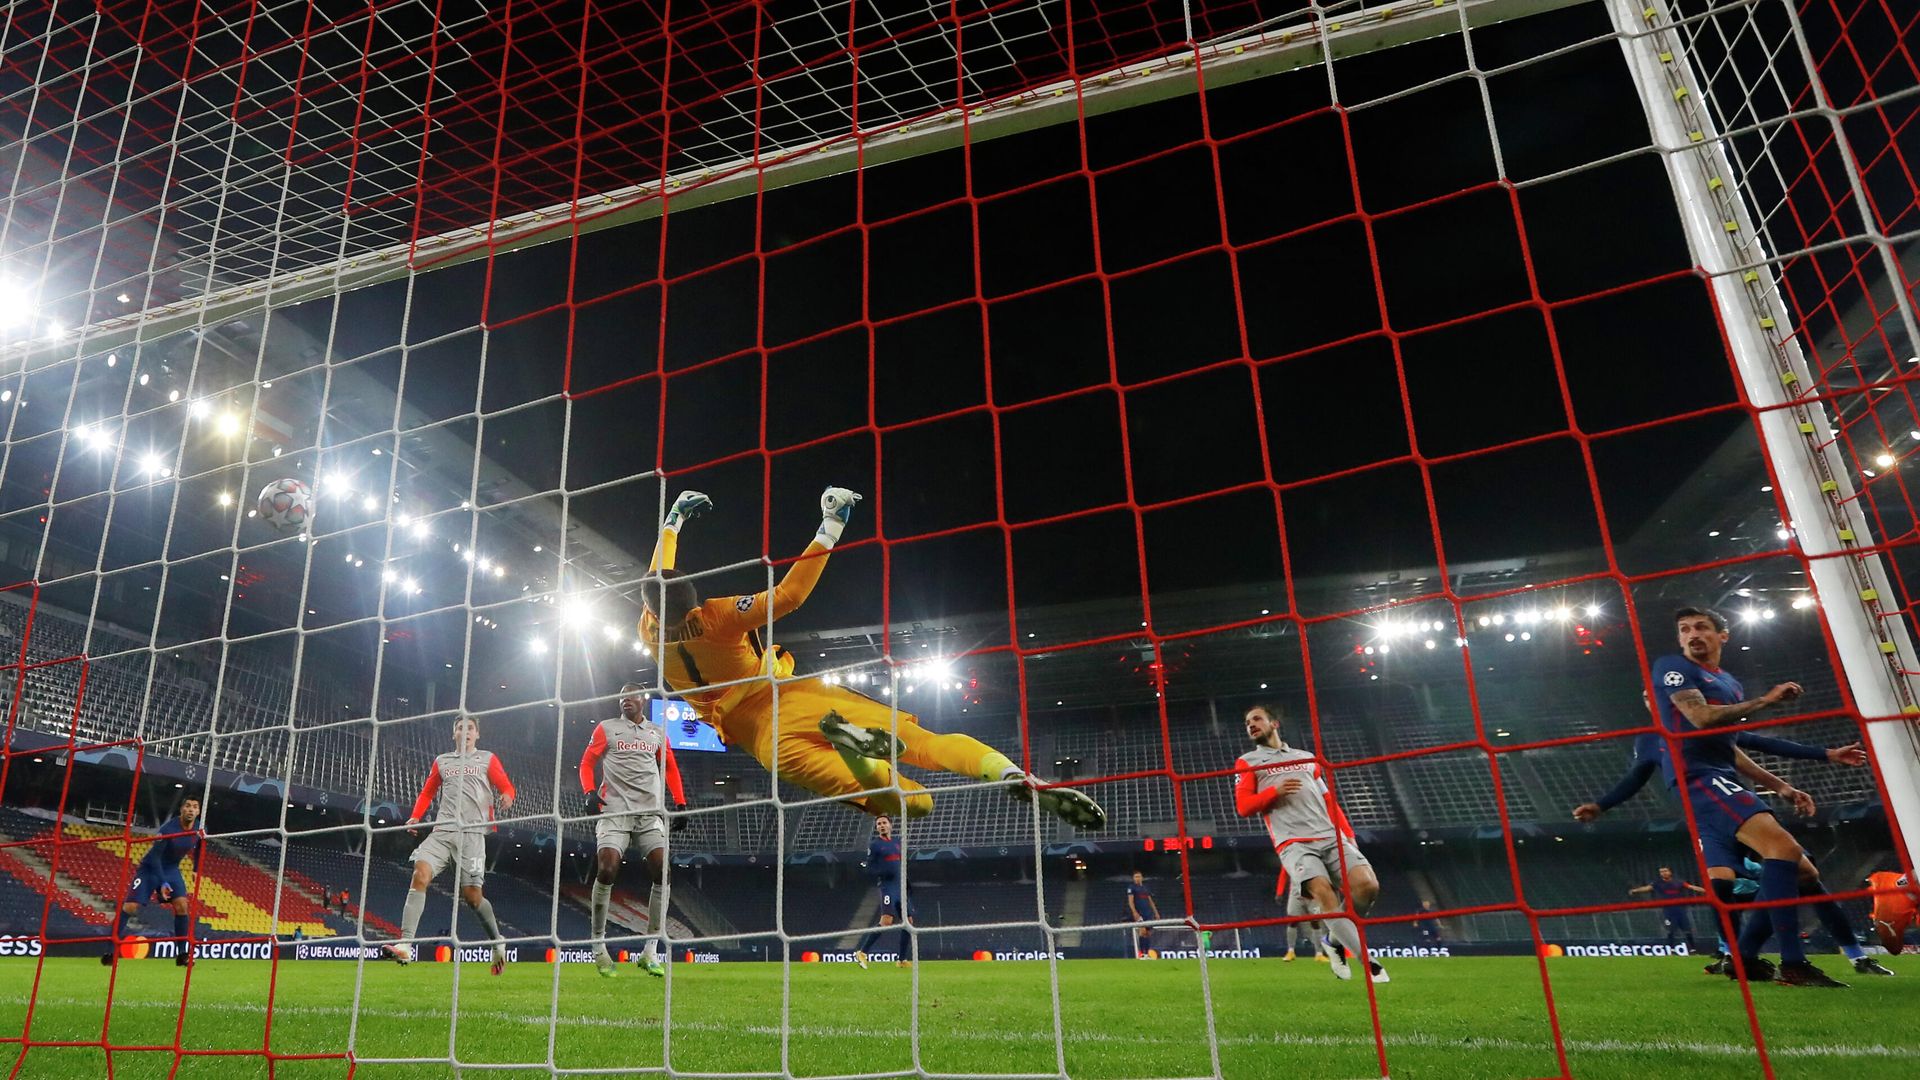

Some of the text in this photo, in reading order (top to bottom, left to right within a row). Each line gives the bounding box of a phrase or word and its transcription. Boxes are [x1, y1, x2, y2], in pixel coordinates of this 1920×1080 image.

[677, 641, 703, 687] 1
[681, 711, 696, 721] 0:0
[616, 740, 658, 752] Red Bull
[463, 765, 480, 776] Bull
[1143, 838, 1154, 852] 0
[1202, 836, 1213, 849] 0
[132, 878, 142, 890] 9
[883, 895, 891, 905] 8
[310, 946, 332, 958] UEFA
[333, 947, 379, 959] CHAMPONS
[694, 952, 720, 963] priceless
